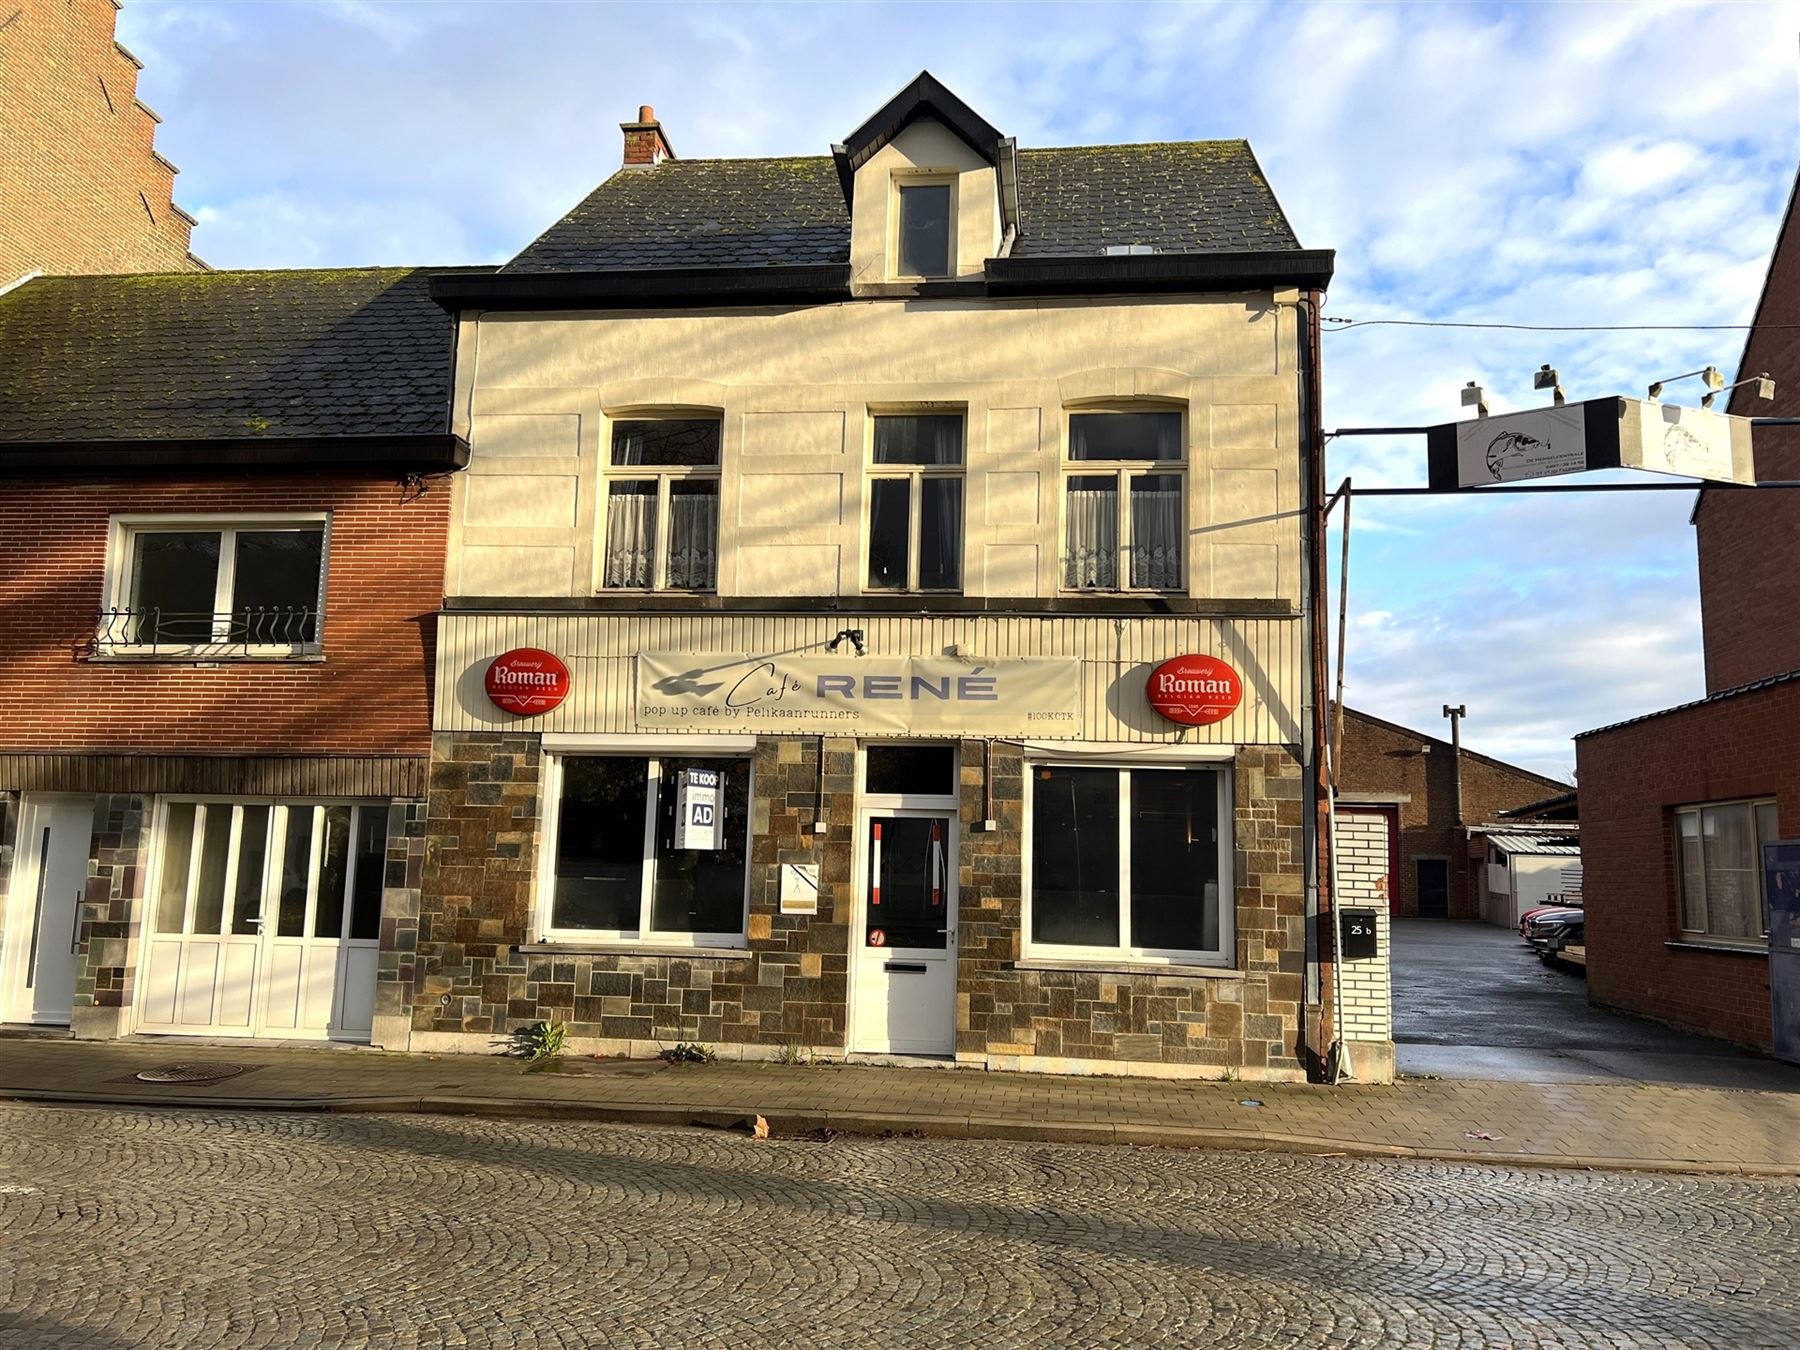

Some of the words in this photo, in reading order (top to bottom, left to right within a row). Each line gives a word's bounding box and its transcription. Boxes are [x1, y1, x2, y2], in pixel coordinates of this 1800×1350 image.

[494, 666, 558, 686] Roman
[1159, 673, 1232, 694] Roman
[726, 662, 801, 708] Café
[816, 666, 998, 701] RENÉ
[644, 704, 667, 716] pop
[671, 706, 689, 718] up
[692, 704, 720, 717] café
[724, 705, 740, 719] by
[746, 706, 861, 720] Pelikaanrunners
[690, 771, 699, 784] TE
[699, 773, 719, 786] KOOP
[692, 790, 715, 803] immo
[693, 806, 713, 823] AD
[1351, 926, 1362, 934] 25
[1366, 927, 1372, 935] b
